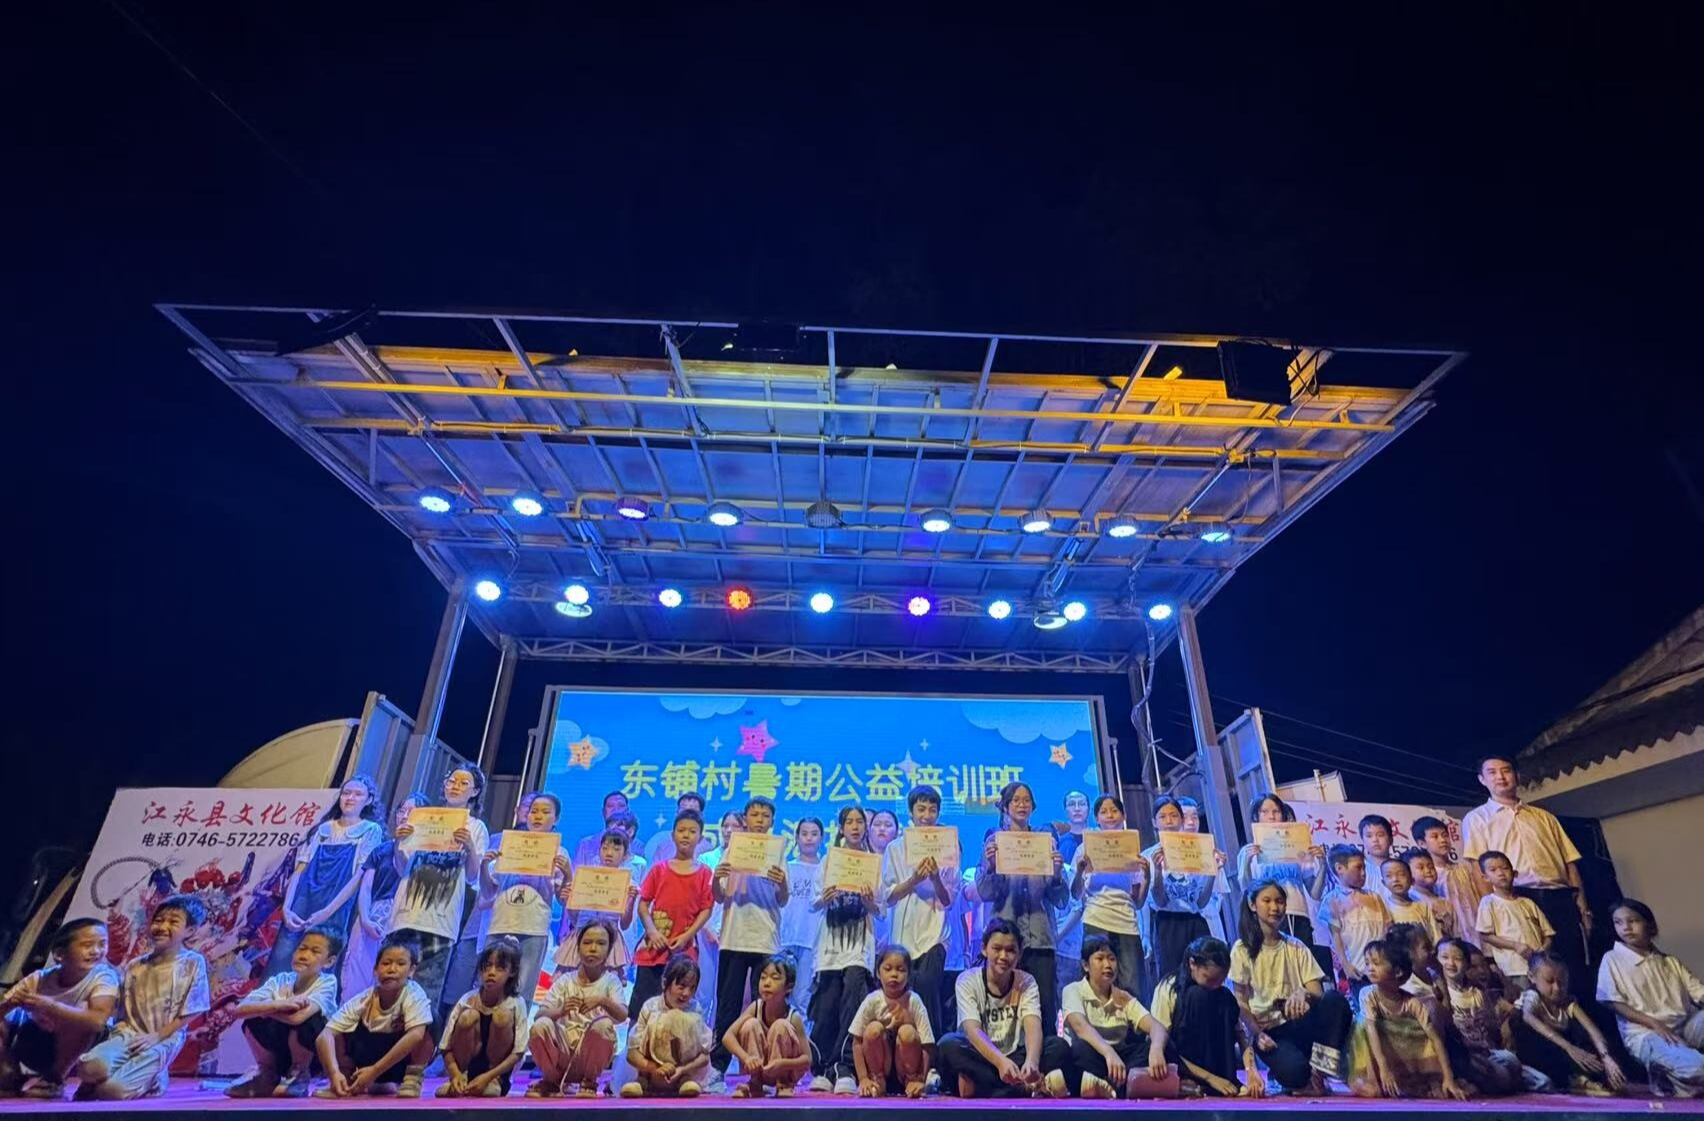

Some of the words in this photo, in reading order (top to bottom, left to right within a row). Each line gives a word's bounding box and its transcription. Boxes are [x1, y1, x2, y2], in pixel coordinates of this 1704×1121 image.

[141, 800, 321, 827] 江永县文化馆
